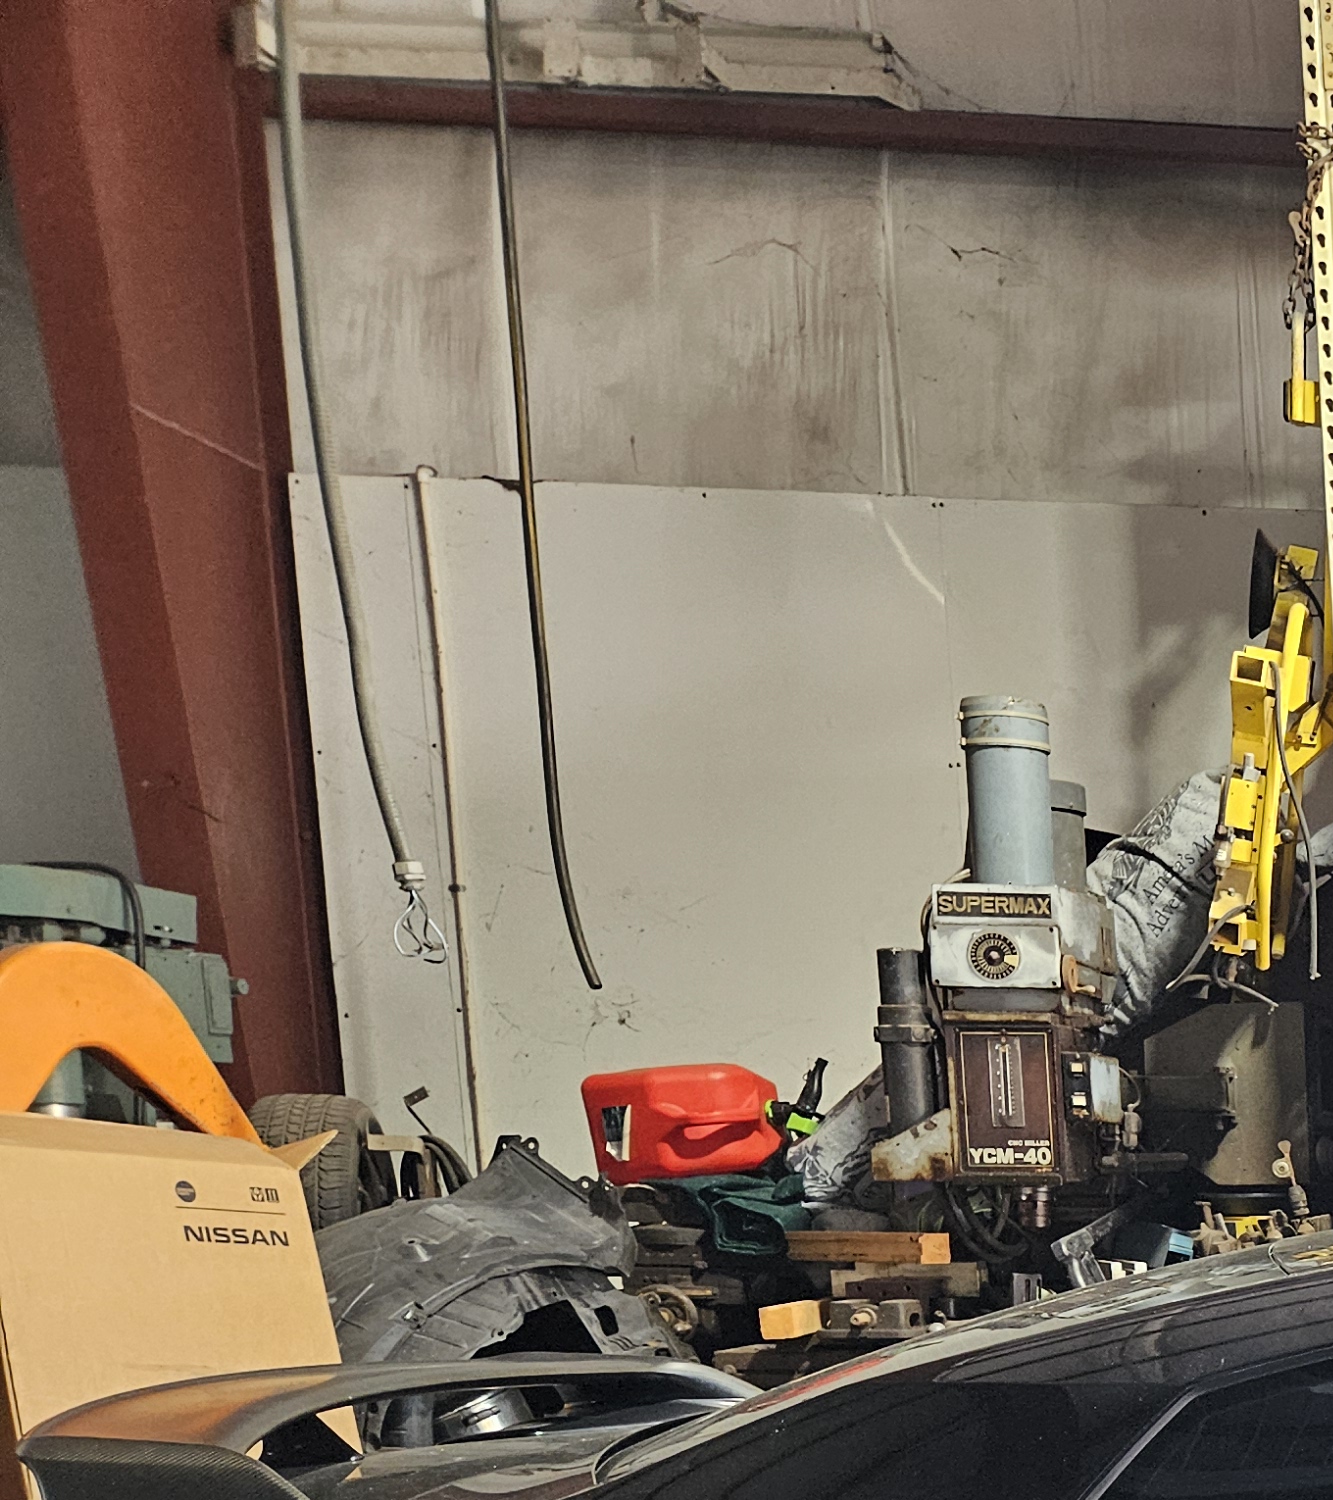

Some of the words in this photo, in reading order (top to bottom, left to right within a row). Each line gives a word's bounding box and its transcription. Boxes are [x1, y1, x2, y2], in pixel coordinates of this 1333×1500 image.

[937, 895, 1050, 915] SUPERMAX
[970, 1146, 1052, 1165] YCM-40
[183, 1225, 290, 1247] NISSAN
